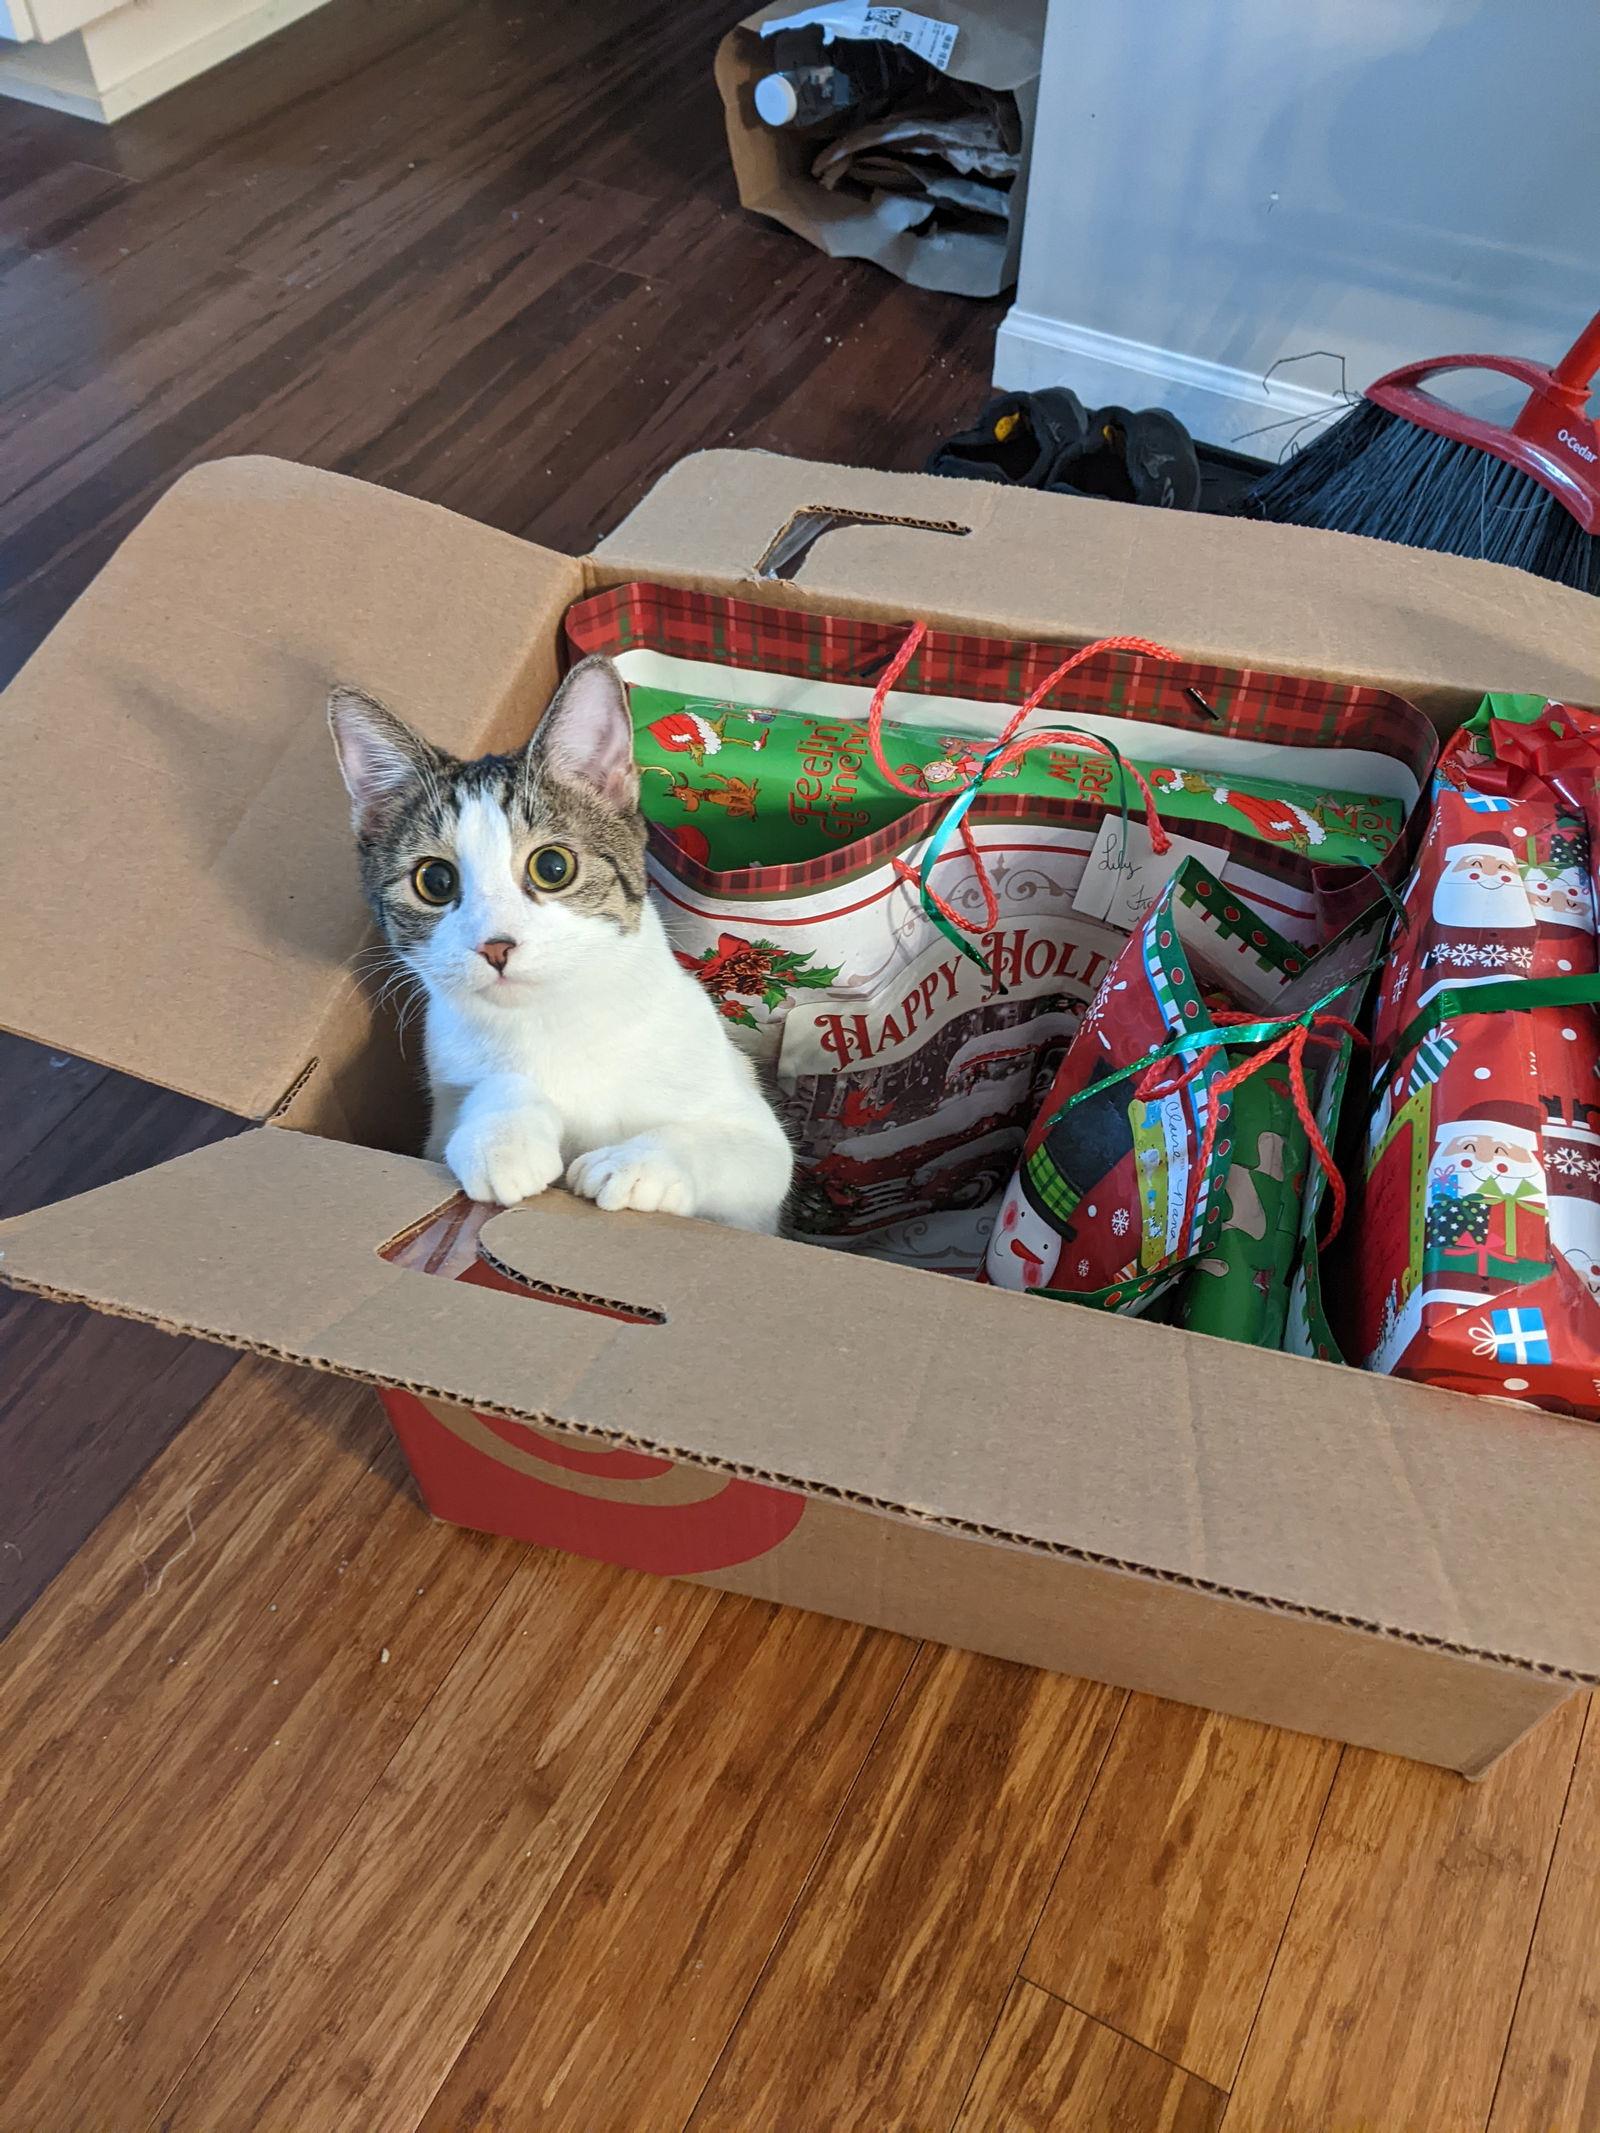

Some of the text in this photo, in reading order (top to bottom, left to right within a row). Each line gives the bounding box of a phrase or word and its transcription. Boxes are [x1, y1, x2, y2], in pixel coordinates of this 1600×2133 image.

[788, 719, 845, 826] Feelin'
[813, 928, 1119, 1074] HAPPY HOLI
[1164, 1101, 1183, 1163] Claire
